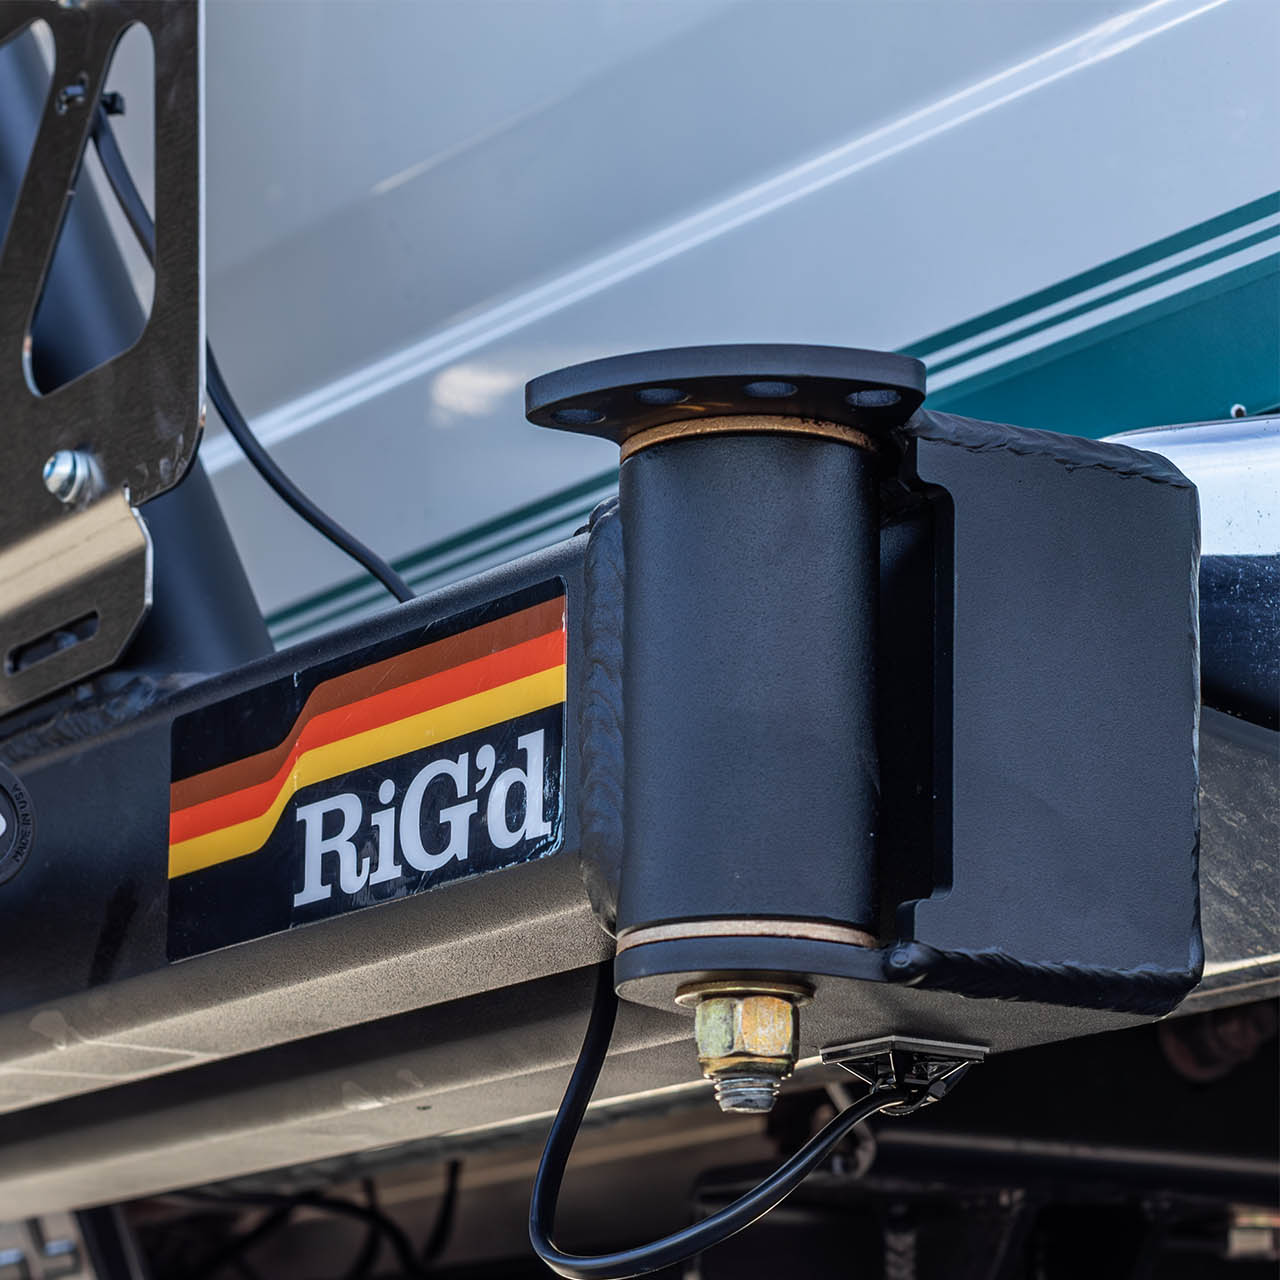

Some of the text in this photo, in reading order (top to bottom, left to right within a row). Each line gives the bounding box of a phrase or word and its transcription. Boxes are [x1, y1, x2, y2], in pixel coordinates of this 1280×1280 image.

[12, 783, 32, 863] MADE IN USA
[293, 729, 552, 908] RiG'd
